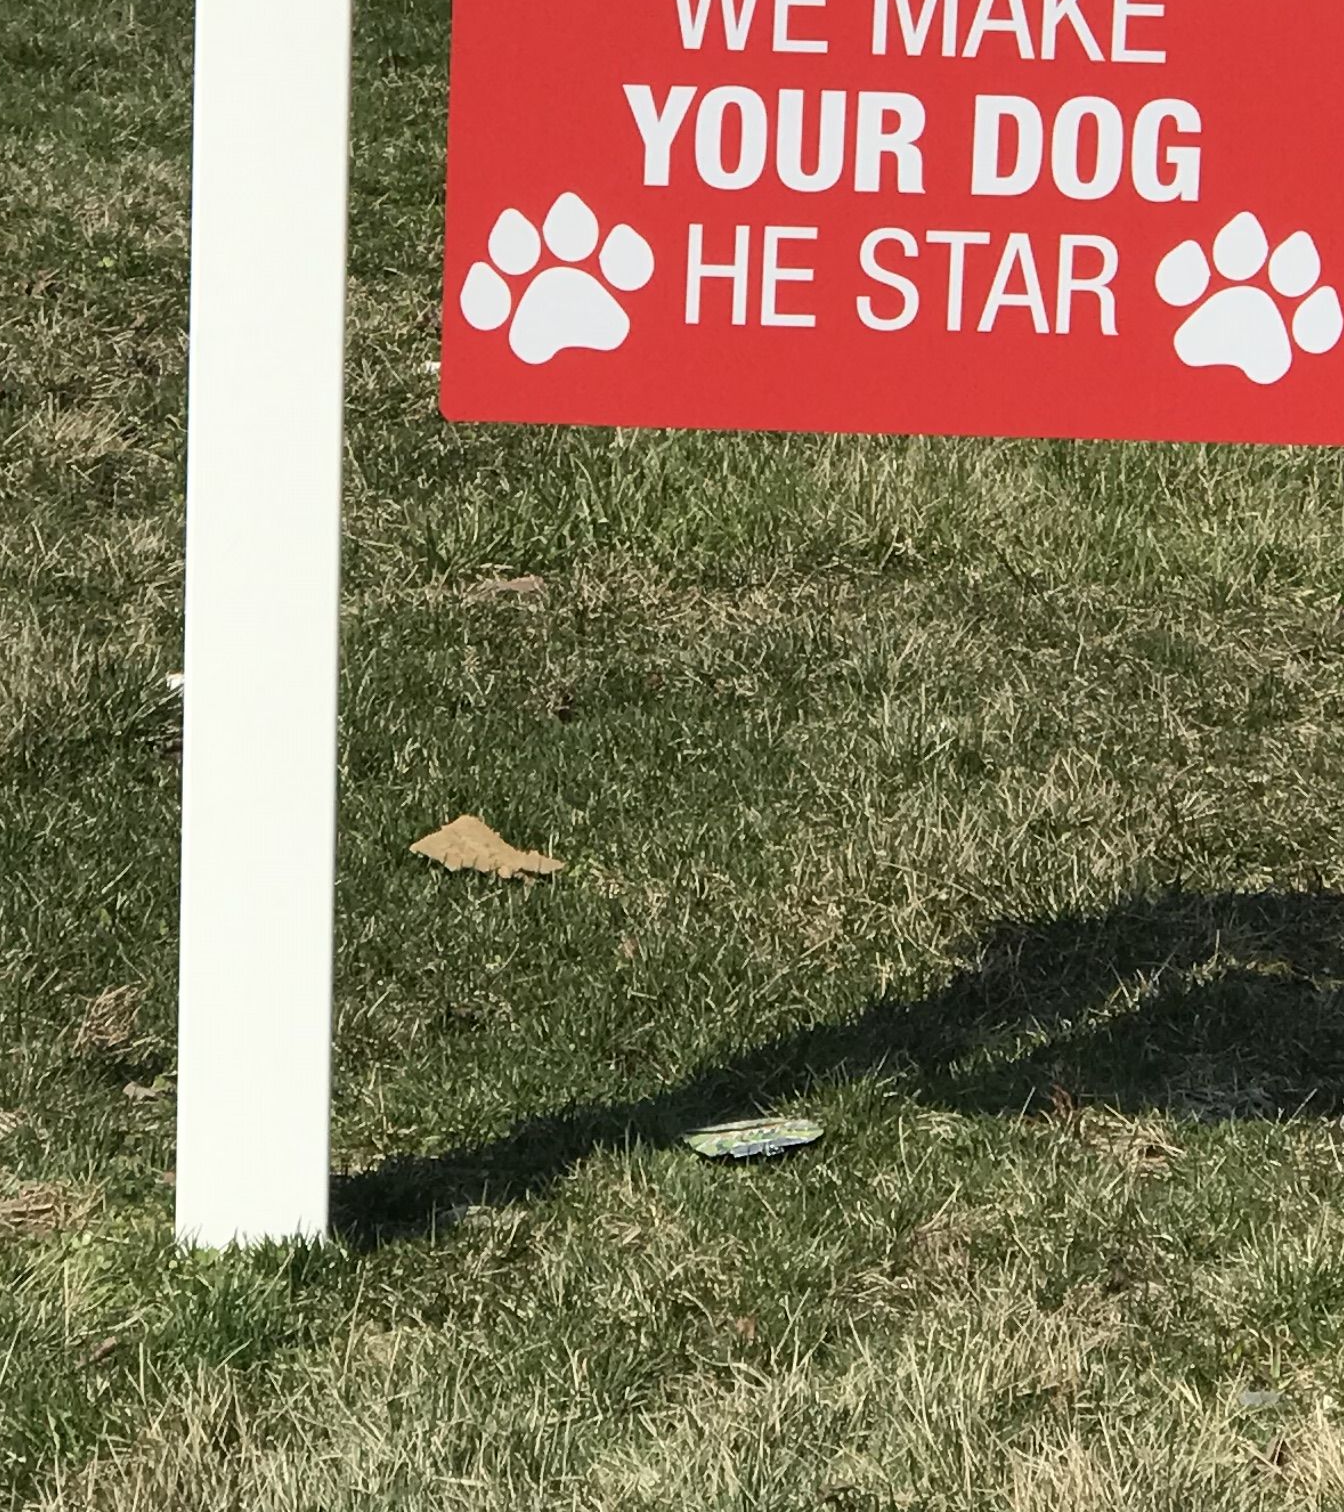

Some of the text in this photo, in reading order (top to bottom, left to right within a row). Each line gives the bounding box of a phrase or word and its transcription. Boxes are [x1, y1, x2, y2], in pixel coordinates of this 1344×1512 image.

[622, 84, 1203, 204] YOUR DOG
[685, 223, 1120, 337] HE STAR
